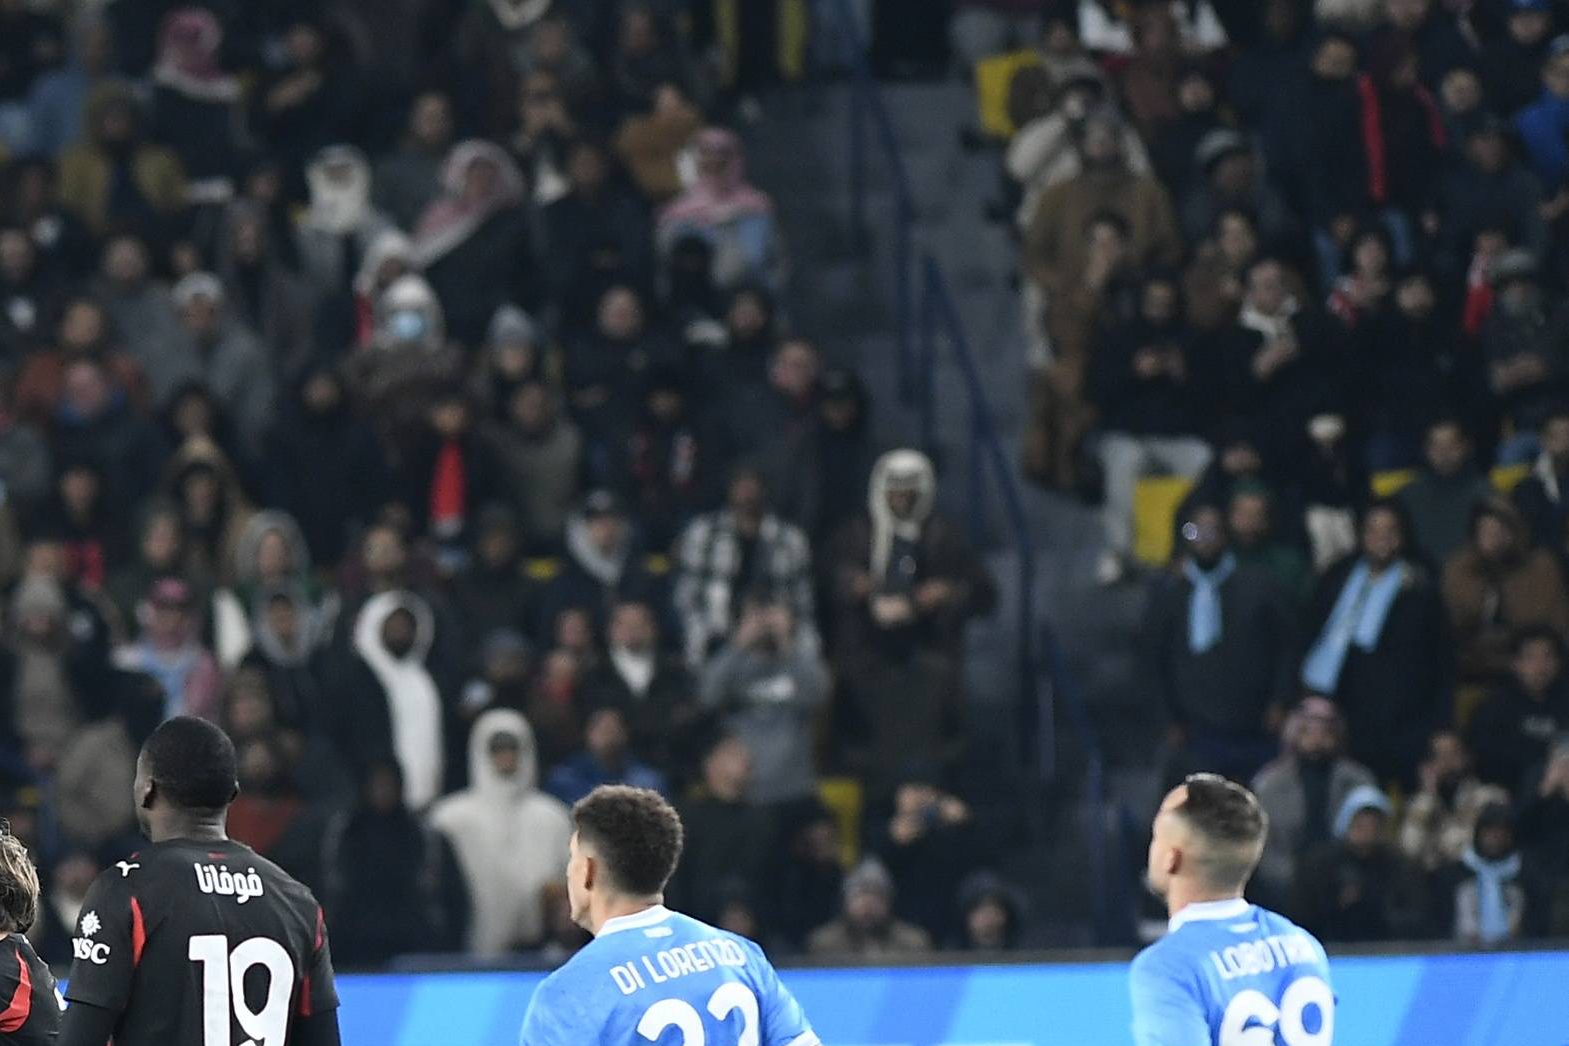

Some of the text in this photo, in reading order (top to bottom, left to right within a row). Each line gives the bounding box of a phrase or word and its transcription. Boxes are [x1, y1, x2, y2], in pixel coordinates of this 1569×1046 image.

[194, 862, 264, 903] فوفانا
[609, 938, 747, 996] DI LORENZO
